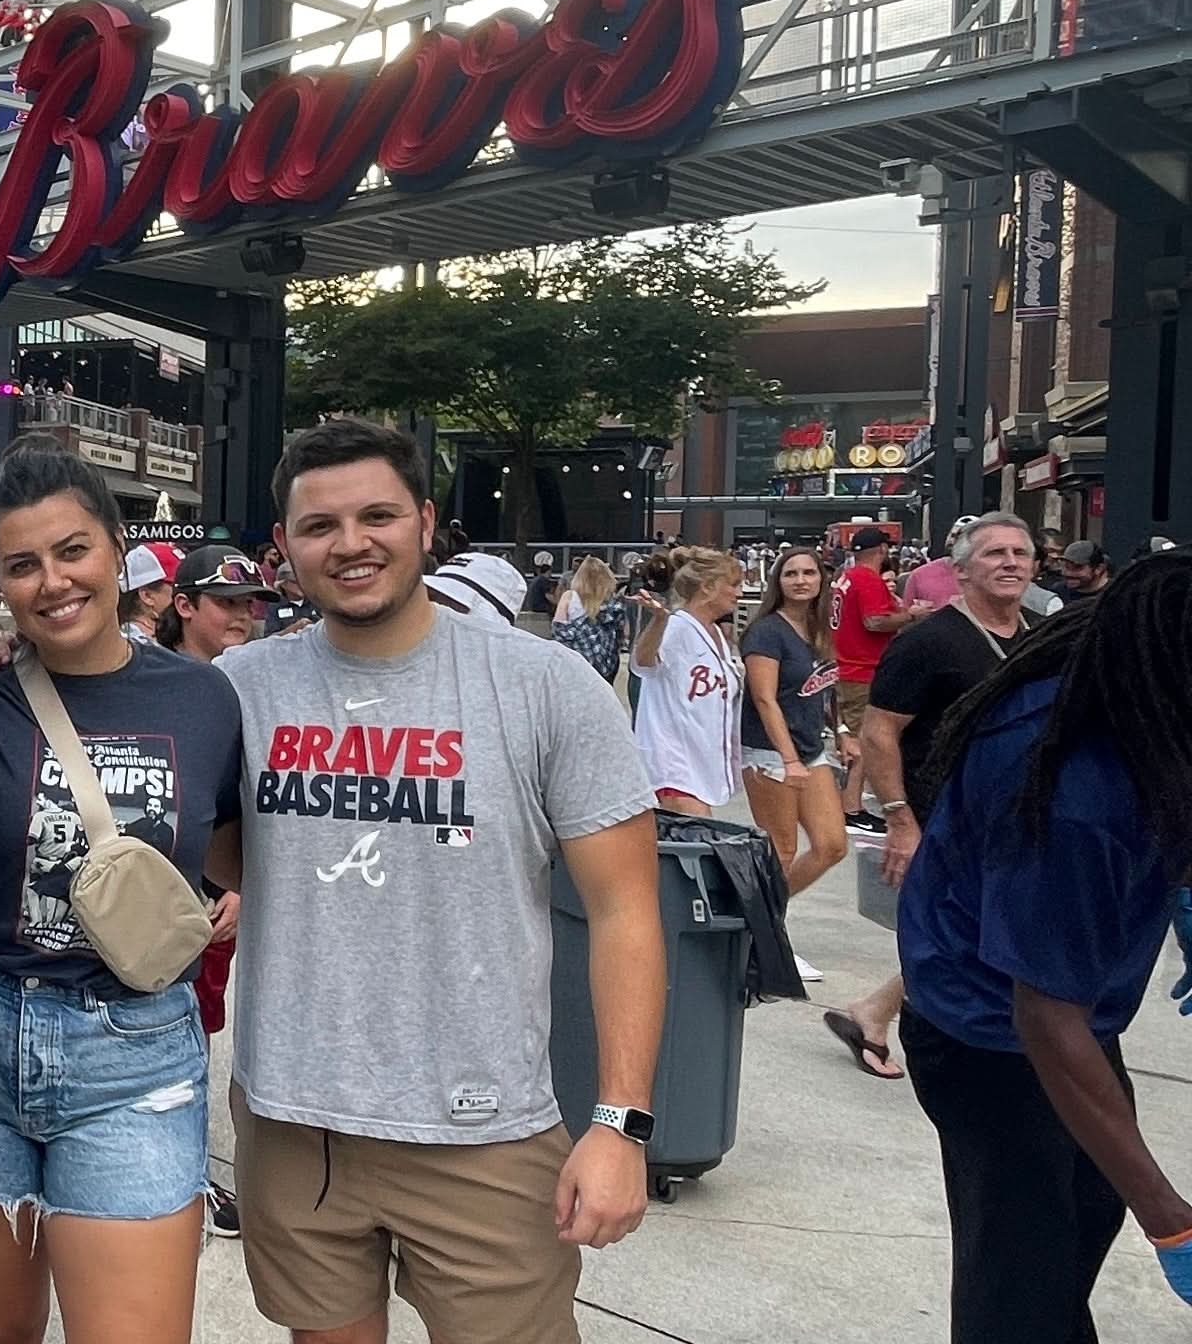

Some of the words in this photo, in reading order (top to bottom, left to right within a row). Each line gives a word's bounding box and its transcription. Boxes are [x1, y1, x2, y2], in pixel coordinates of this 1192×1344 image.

[123, 524, 205, 540] SAMIGOS
[94, 744, 140, 756] Atlanta
[268, 724, 465, 778] BRAVES
[40, 759, 175, 799] CMPS!
[256, 770, 475, 827] BASEBALL
[53, 823, 67, 844] 5
